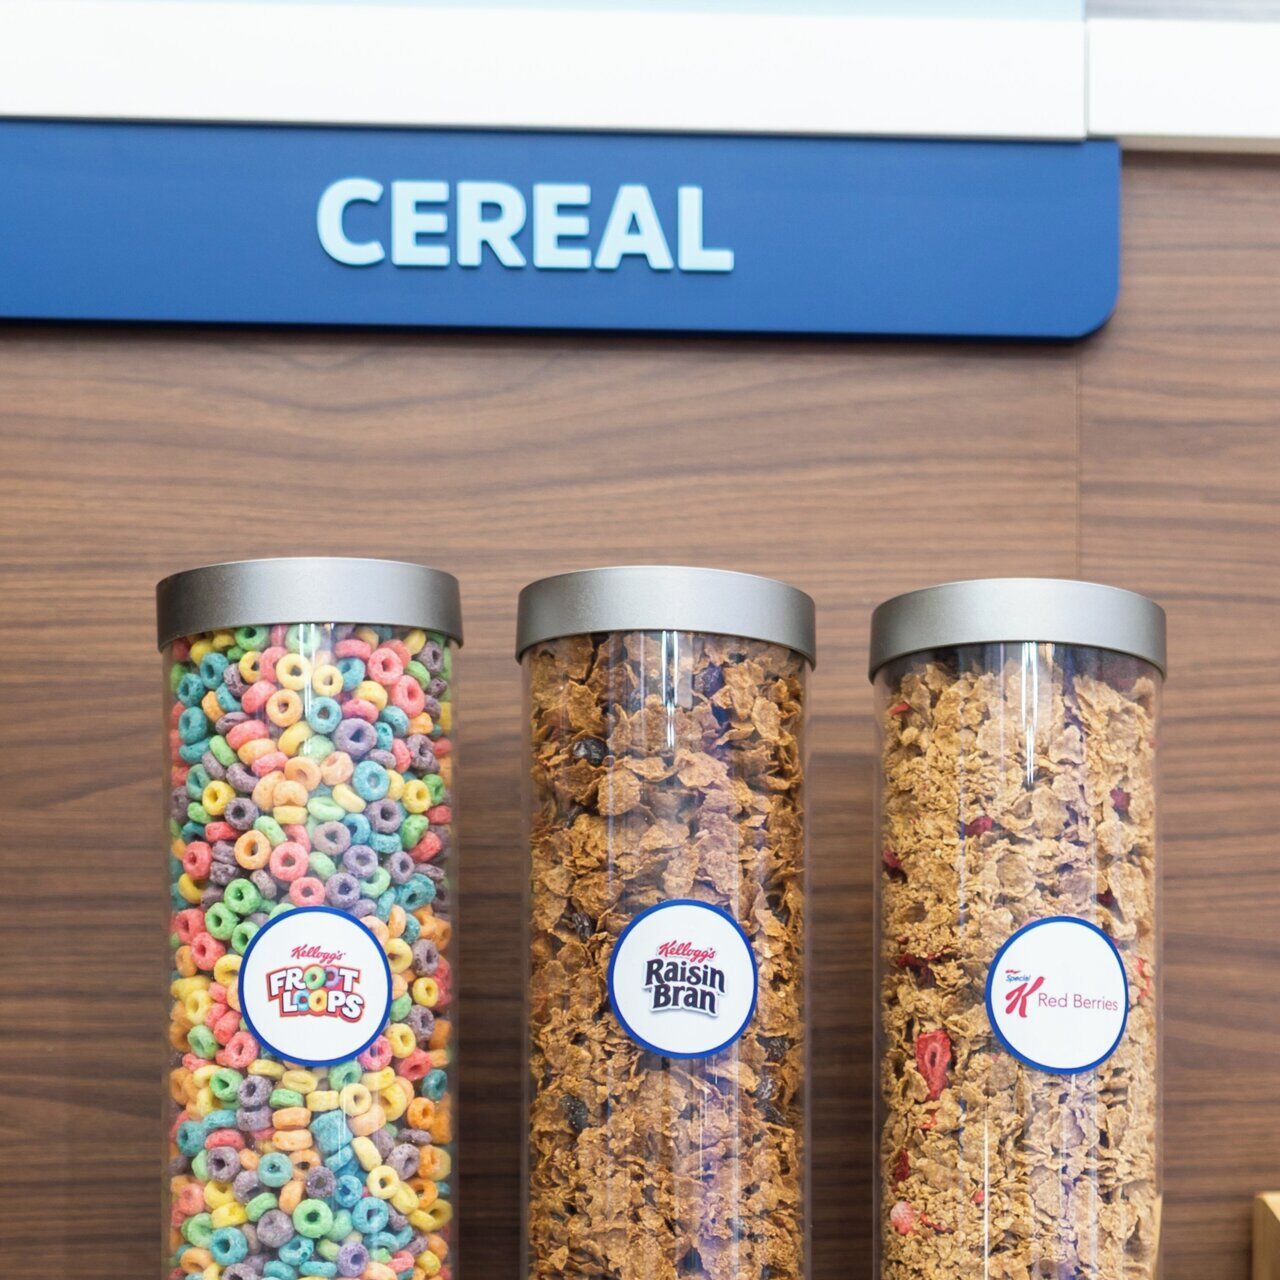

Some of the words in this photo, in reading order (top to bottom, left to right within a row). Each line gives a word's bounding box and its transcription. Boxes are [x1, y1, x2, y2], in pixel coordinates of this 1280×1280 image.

[316, 177, 735, 273] CEREAL
[290, 944, 344, 964] Kellogg's
[658, 940, 717, 964] Kellogg's
[268, 965, 360, 998] FROOT
[645, 959, 726, 993] Raisin
[1005, 974, 1031, 982] Special
[282, 989, 365, 1020] LOOPS
[652, 984, 717, 1014] Bran
[1005, 976, 1045, 1018] K
[1038, 993, 1068, 1008] Red
[1073, 995, 1118, 1011] Berries
